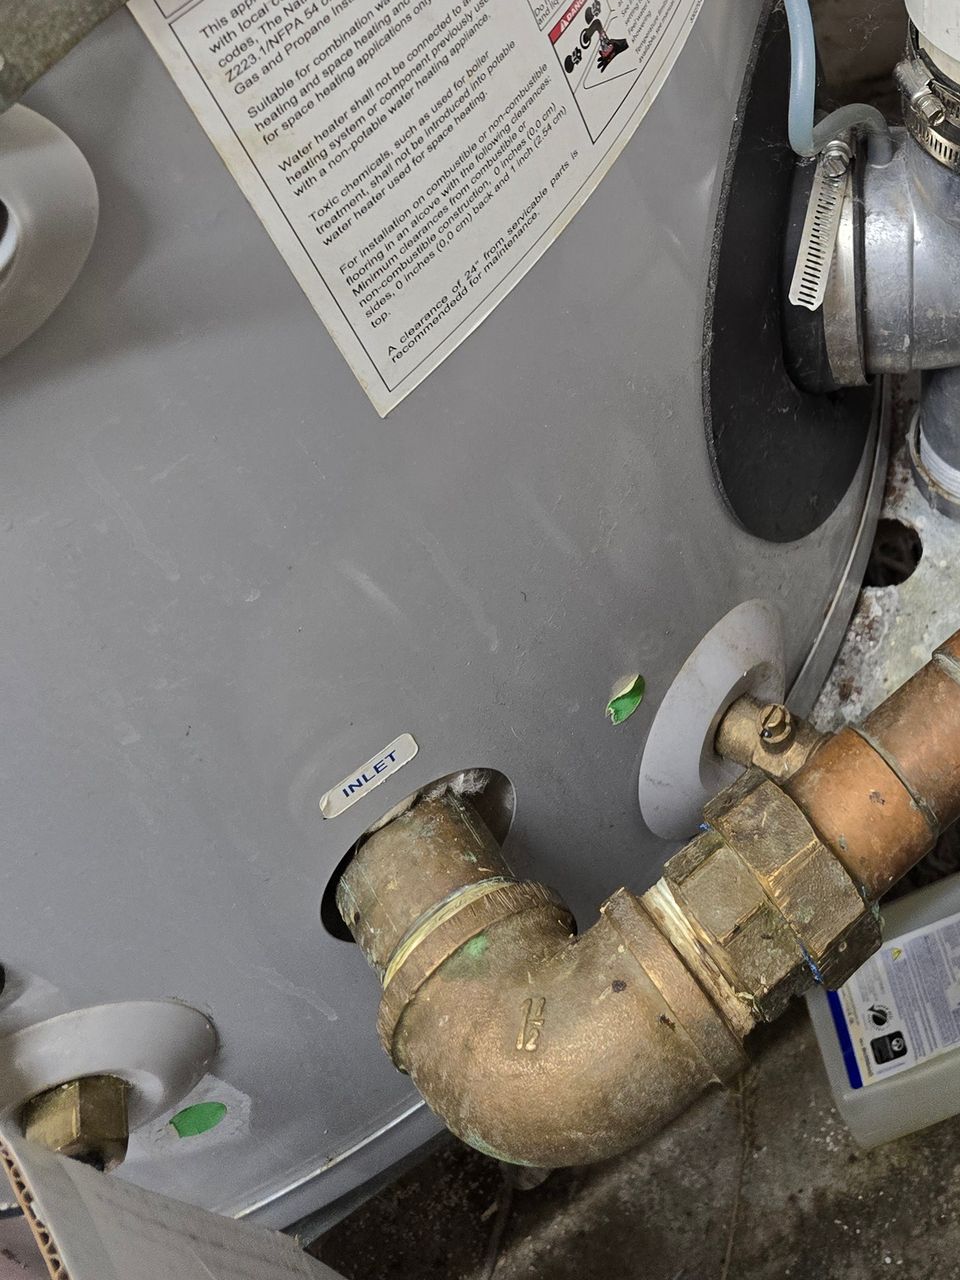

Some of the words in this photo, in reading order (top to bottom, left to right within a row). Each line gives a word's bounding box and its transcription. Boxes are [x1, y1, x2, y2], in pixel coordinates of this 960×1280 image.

[198, 16, 229, 39] This
[208, 30, 238, 54] with
[237, 2, 270, 33] local
[257, 15, 283, 35] The
[303, 2, 320, 20] 54
[233, 72, 260, 95] Gas
[260, 50, 284, 76] and
[283, 14, 331, 56] Propane
[247, 79, 295, 119] Suitable
[294, 63, 311, 81] for
[312, 10, 375, 67] combination
[277, 141, 313, 172] Water
[313, 110, 349, 145] heater
[349, 86, 375, 114] shall
[374, 72, 393, 92] not
[390, 60, 406, 76] be
[406, 12, 453, 63] connected
[451, 5, 462, 17] to
[285, 148, 329, 186] heating
[328, 115, 367, 151] system
[366, 102, 378, 117] or
[379, 53, 432, 106] component
[430, 10, 473, 59] previously
[292, 175, 318, 197] with
[318, 167, 328, 178] a
[327, 113, 388, 169] non-potable
[387, 86, 415, 115] water
[414, 54, 450, 90] heating
[339, 255, 358, 276] For
[358, 208, 412, 259] installation
[412, 195, 426, 210] on
[426, 142, 478, 197] combustible
[478, 130, 488, 144] or
[487, 63, 548, 134] non-combustible
[388, 345, 398, 357] A
[399, 295, 449, 344] clearance
[451, 279, 462, 294] of
[483, 237, 505, 261] from
[506, 187, 548, 236] servicable
[549, 160, 570, 189] parts
[570, 150, 579, 160] is
[468, 271, 482, 288] for
[342, 749, 396, 797] INLET
